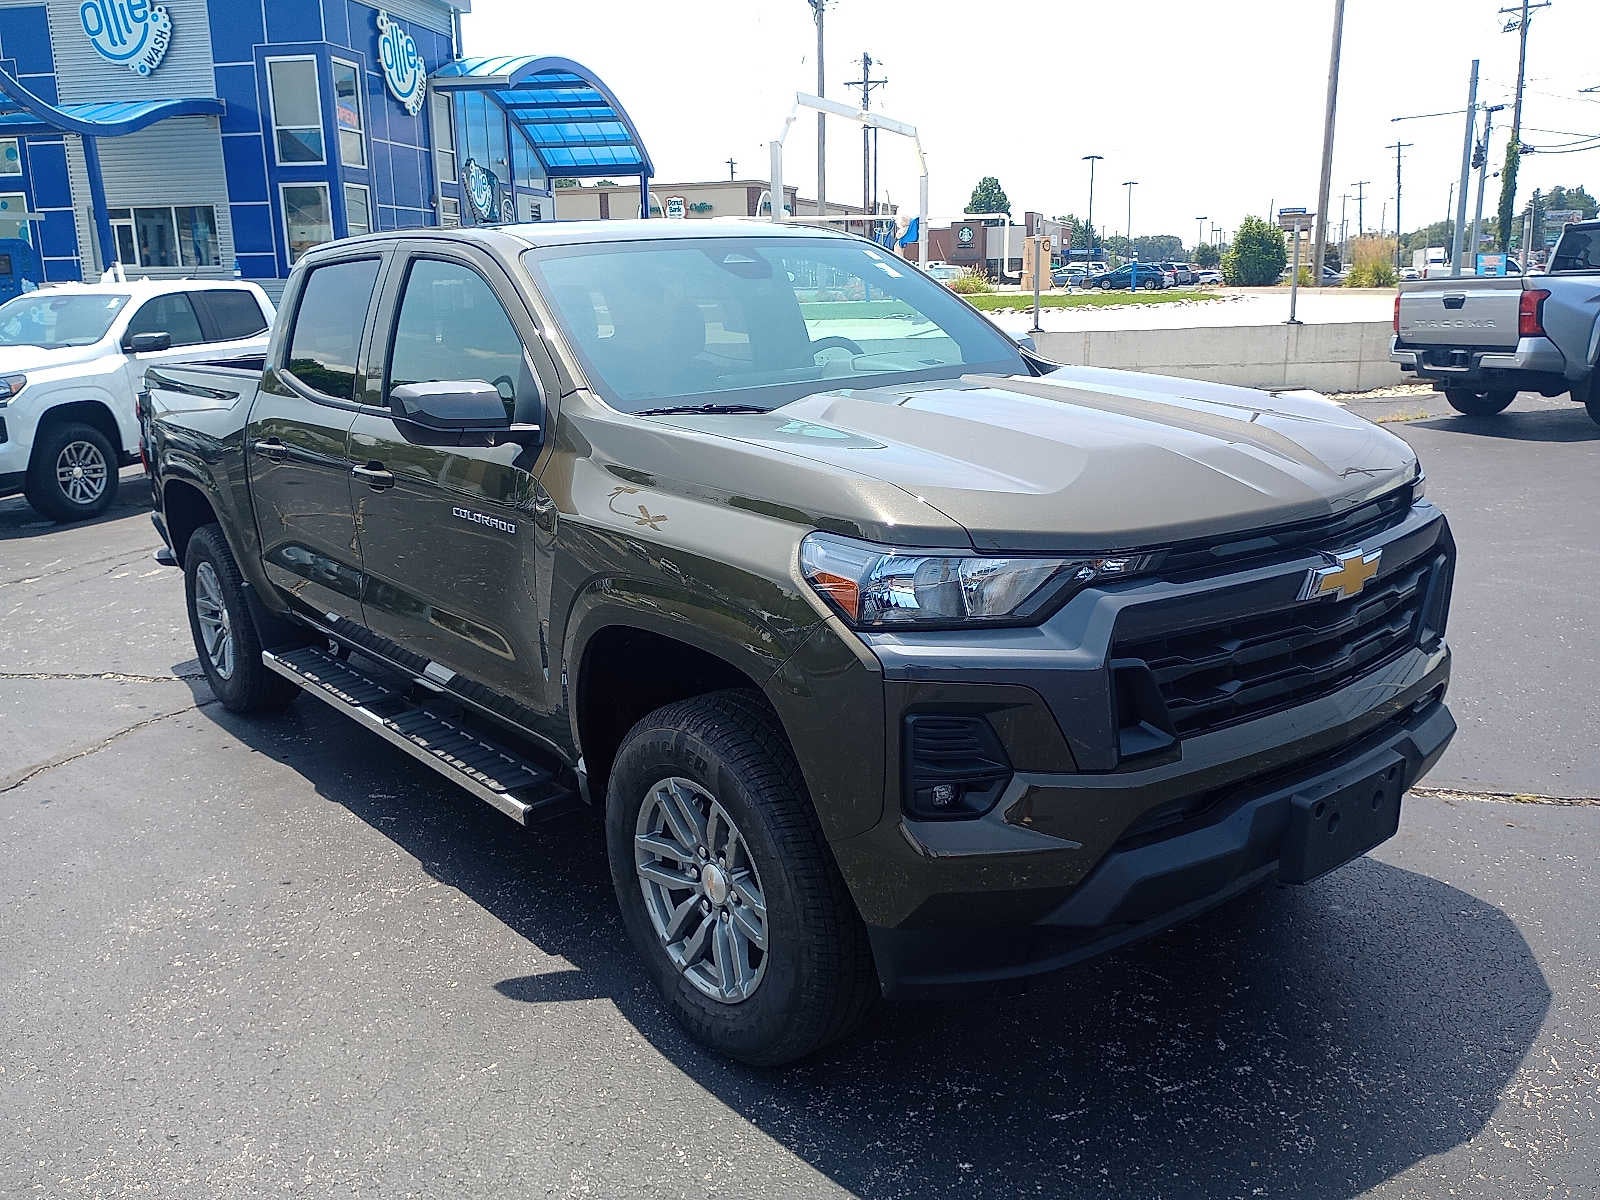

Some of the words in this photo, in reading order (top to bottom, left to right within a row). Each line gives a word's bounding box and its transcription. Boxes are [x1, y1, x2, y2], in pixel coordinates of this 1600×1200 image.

[81, 0, 149, 47] ollie
[143, 29, 168, 66] WASH
[382, 25, 416, 83] ollie
[413, 78, 426, 110] WASH
[1414, 320, 1497, 328] TACOMA
[452, 507, 516, 534] COLORADO
